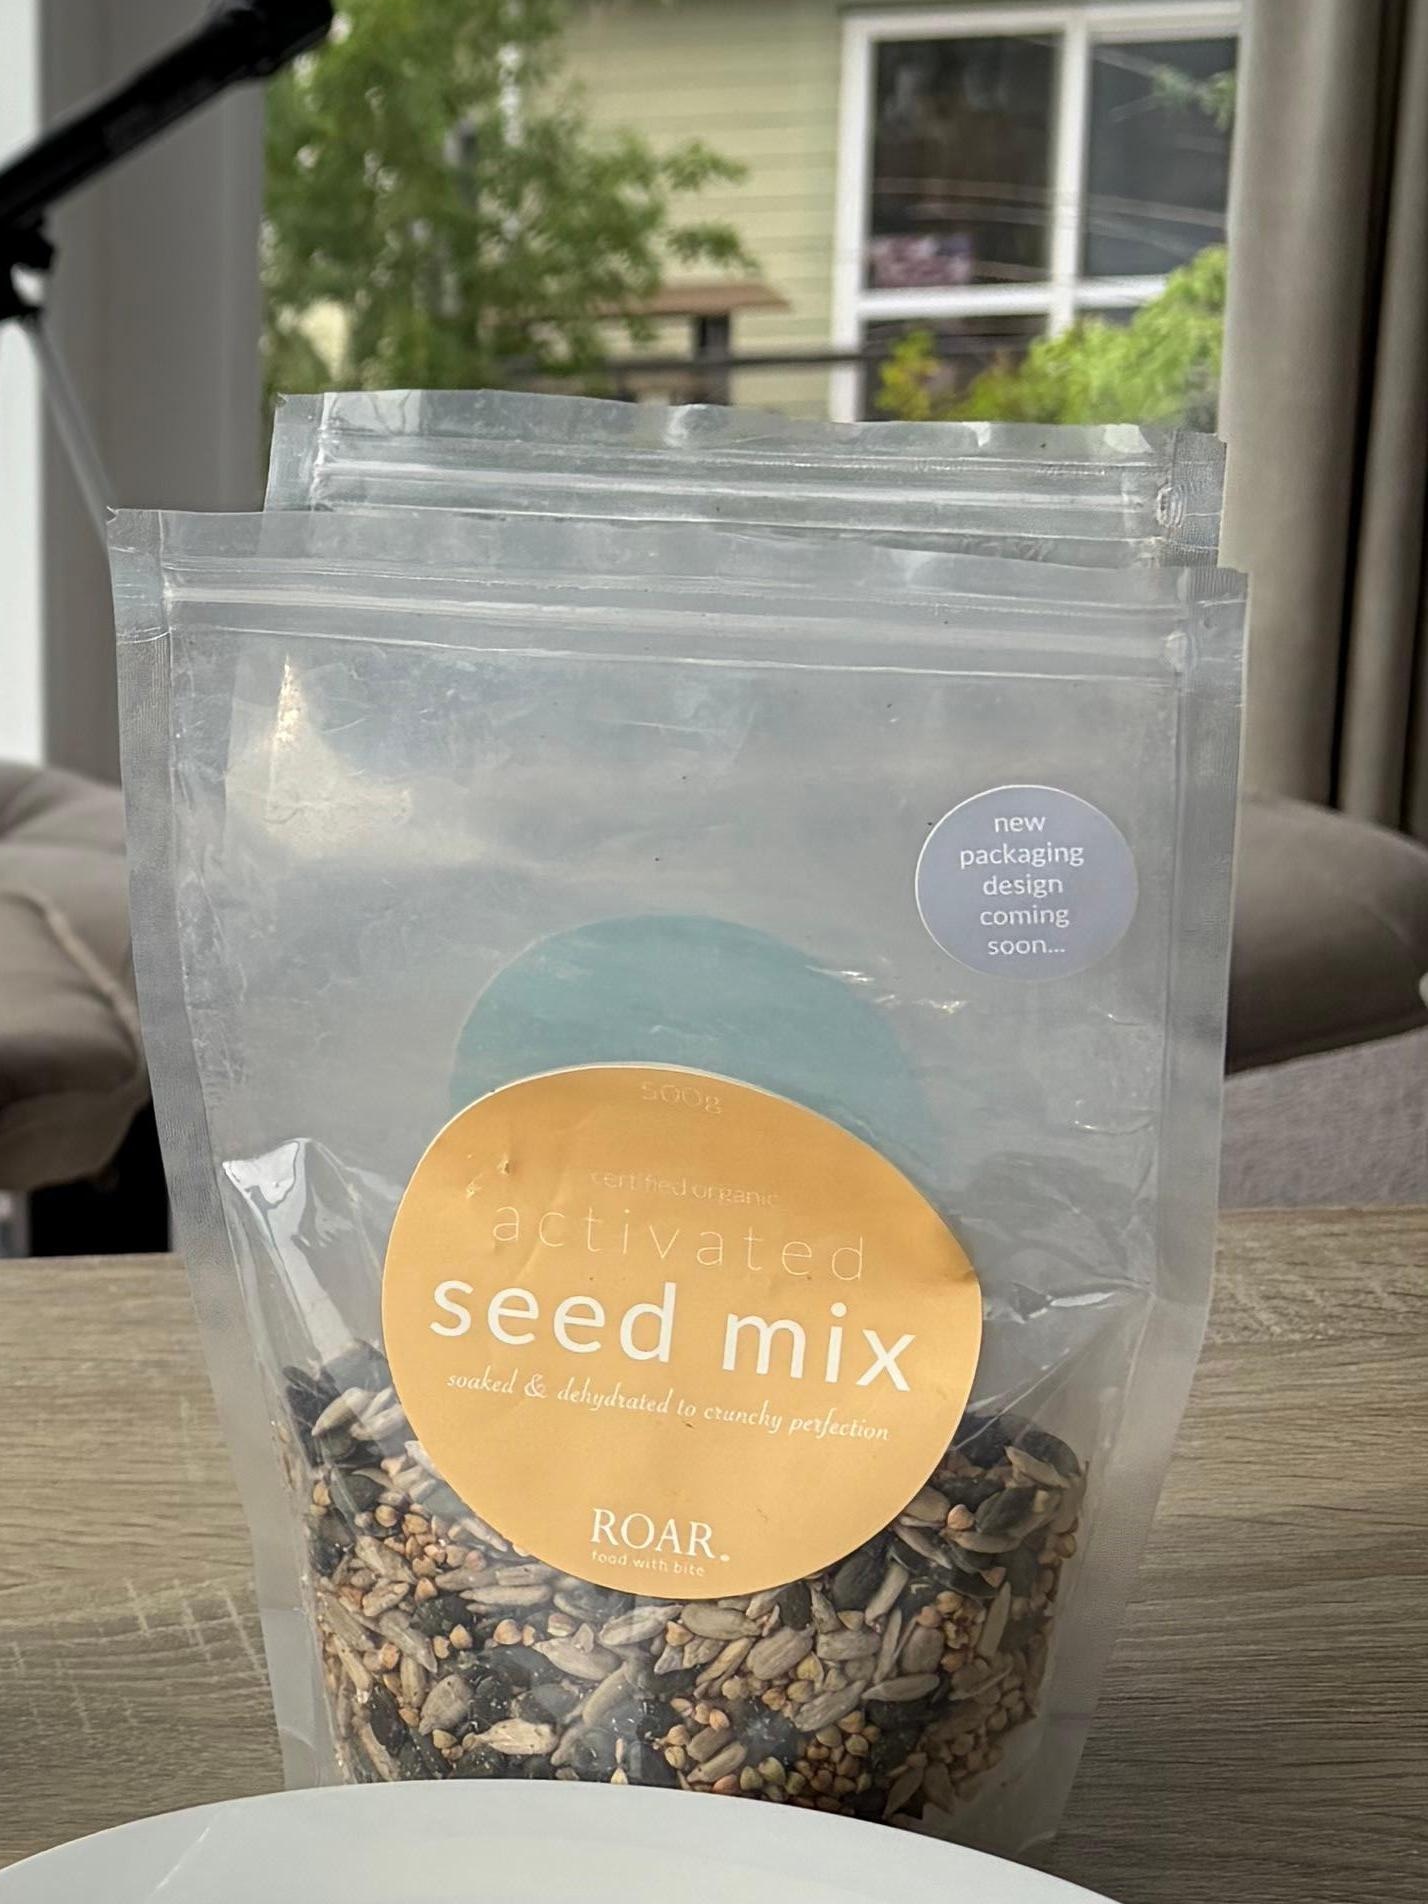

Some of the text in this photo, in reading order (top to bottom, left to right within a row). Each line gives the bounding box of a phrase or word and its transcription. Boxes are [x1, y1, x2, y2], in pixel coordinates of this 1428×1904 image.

[994, 815, 1046, 833] new
[960, 841, 1085, 869] packaging
[983, 874, 1064, 898] design
[980, 905, 1070, 929] coming
[988, 938, 1066, 956] soon...
[641, 1081, 722, 1114] 500g
[493, 1206, 865, 1281] activated
[430, 1278, 917, 1393] seed mix
[446, 1366, 891, 1441] soaked & dehydrated to crunchy perfection
[590, 1508, 731, 1563] ROAR.
[591, 1549, 706, 1578] food with bite
